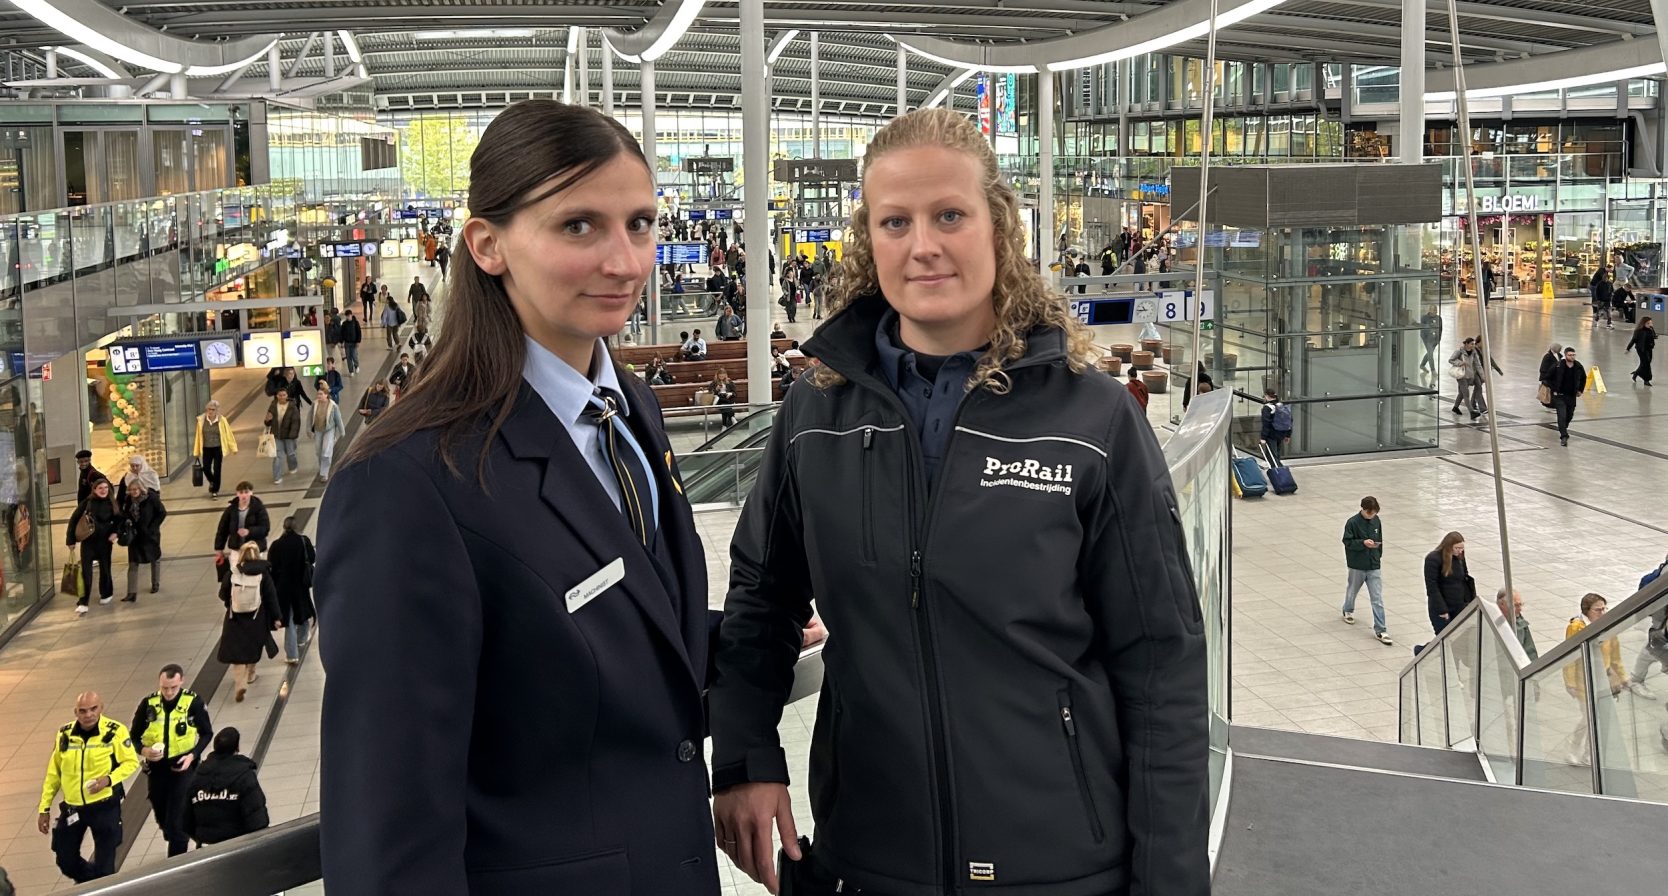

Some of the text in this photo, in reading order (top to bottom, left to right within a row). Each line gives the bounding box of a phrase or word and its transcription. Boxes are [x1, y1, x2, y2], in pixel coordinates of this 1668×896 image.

[1482, 195, 1539, 212] BLOEM!
[1166, 302, 1176, 319] 8
[257, 346, 270, 364] 8
[297, 344, 310, 362] 9
[983, 456, 1073, 482] ProRail
[980, 478, 1072, 496] Incidentenbestrijding
